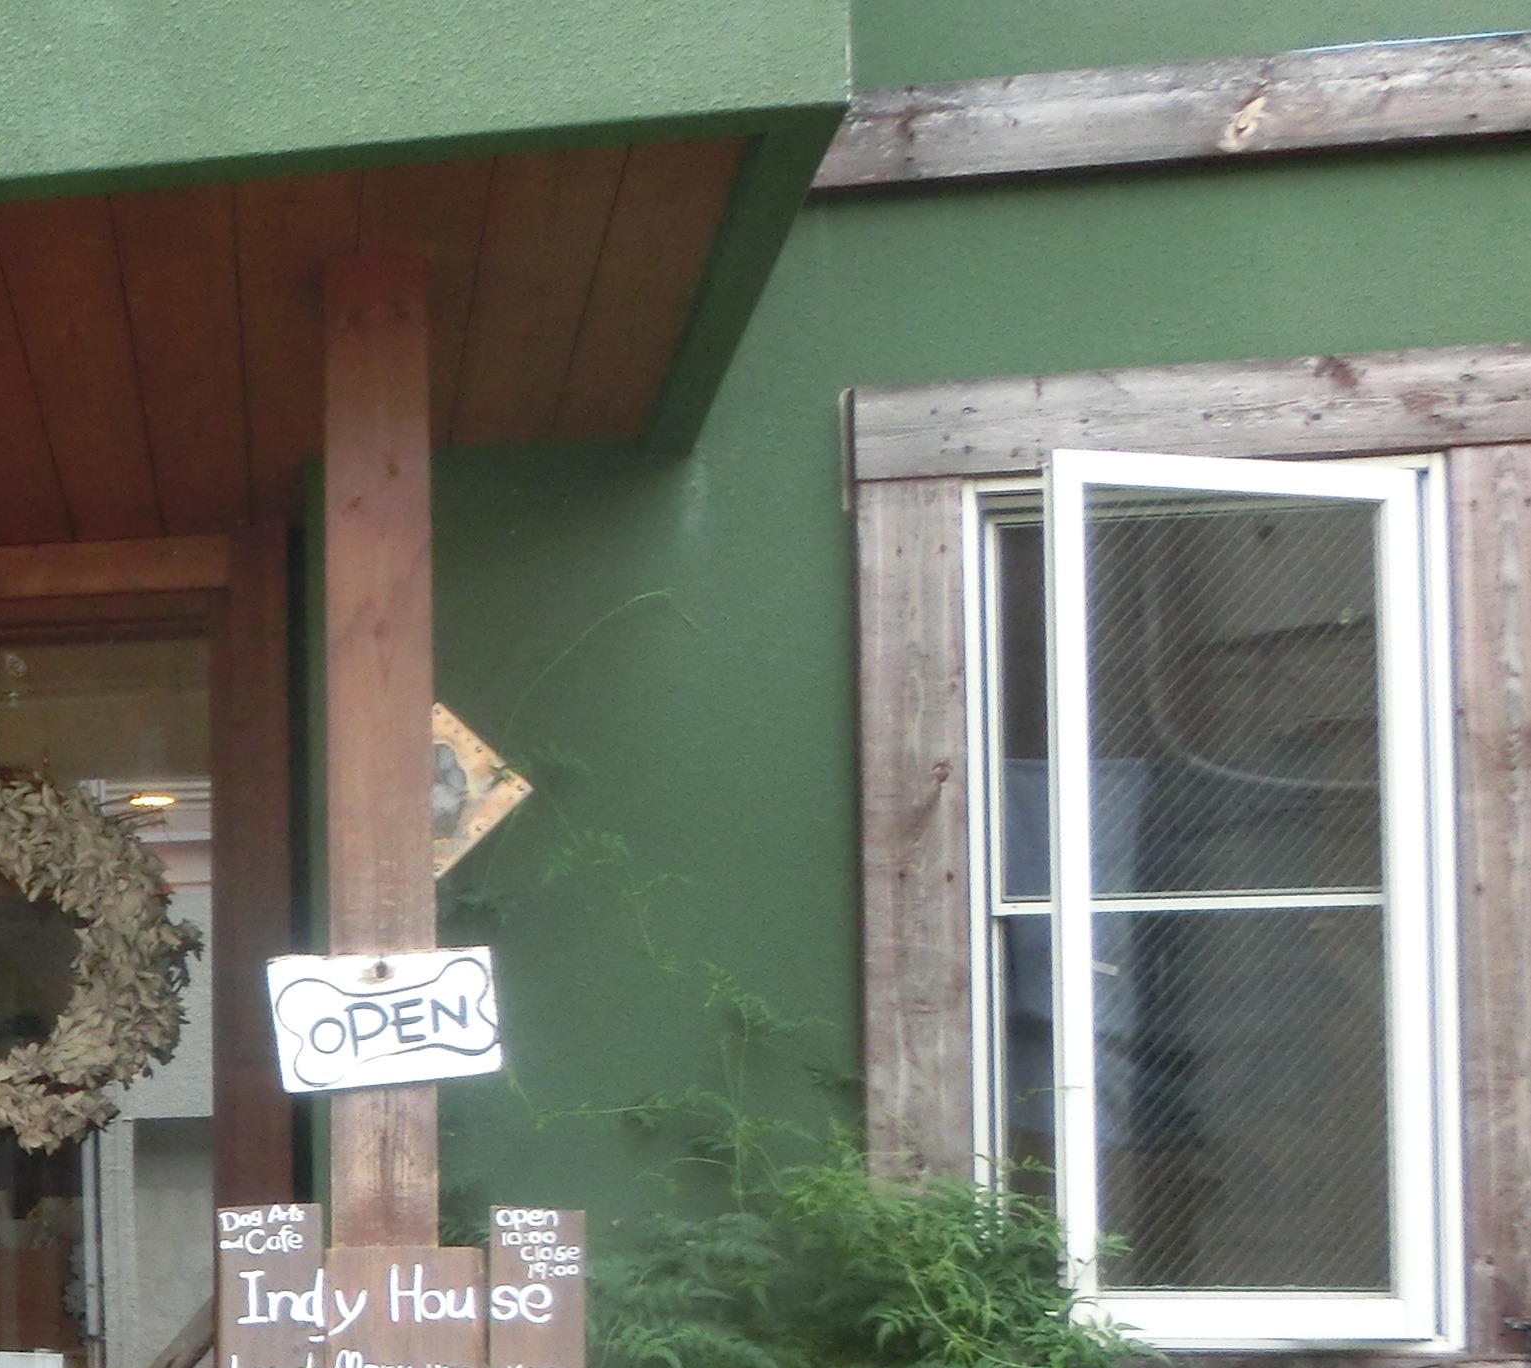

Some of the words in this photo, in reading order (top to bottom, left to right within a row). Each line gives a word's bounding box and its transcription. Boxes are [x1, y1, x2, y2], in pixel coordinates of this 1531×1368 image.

[309, 995, 468, 1058] OPEN
[218, 1210, 263, 1232] Dog
[267, 1203, 305, 1223] Arts
[245, 1224, 303, 1254] Cafe
[501, 1231, 558, 1247] 10:00
[527, 1262, 579, 1280] 19:00
[238, 1267, 368, 1338] Indy
[390, 1264, 554, 1324] House
